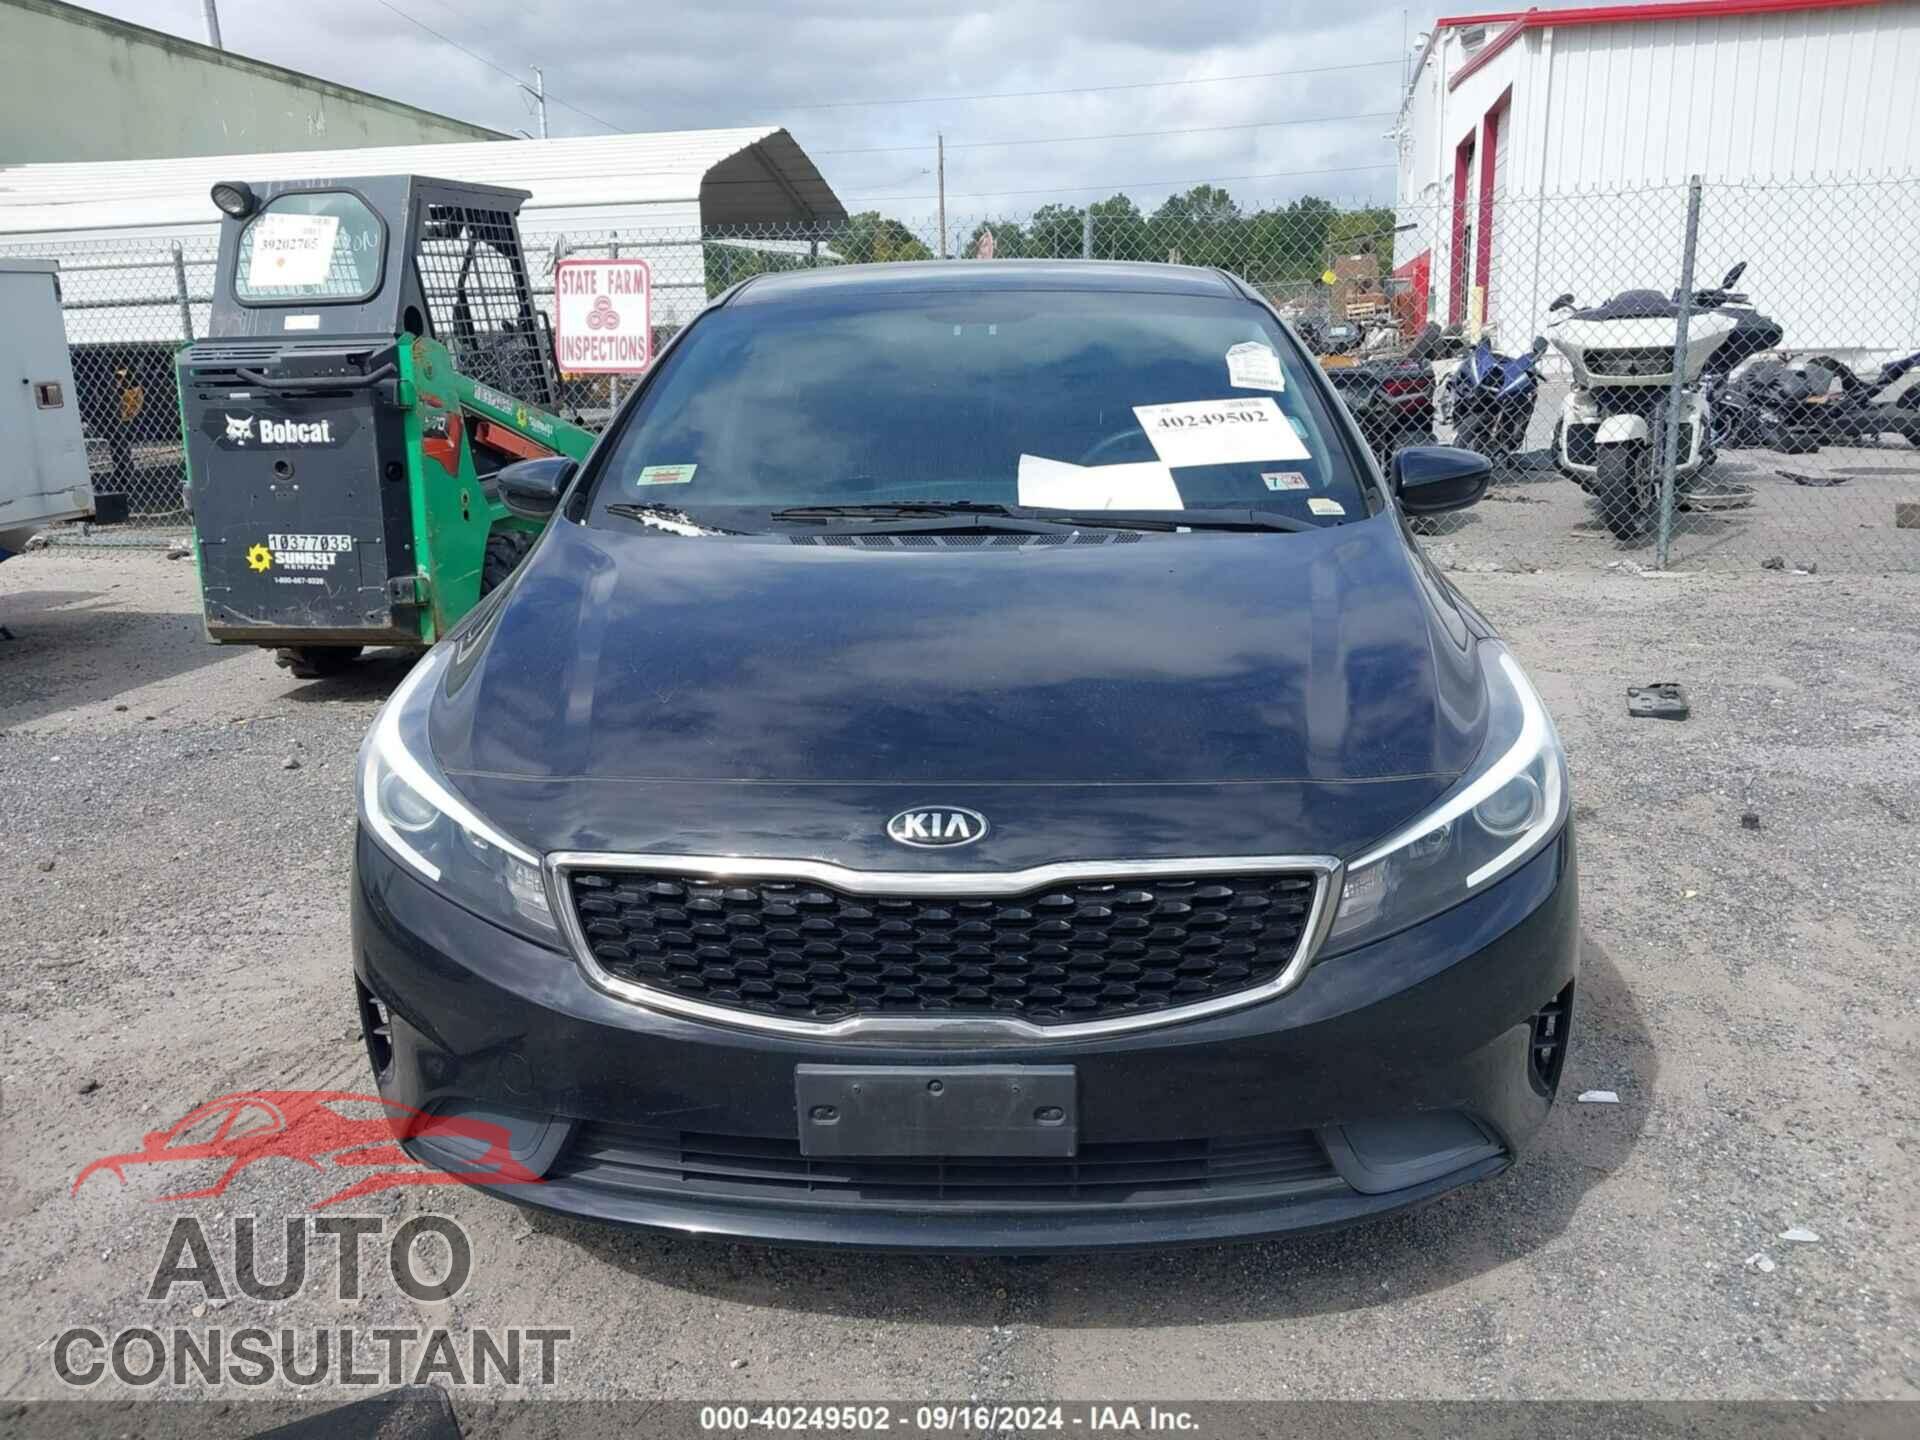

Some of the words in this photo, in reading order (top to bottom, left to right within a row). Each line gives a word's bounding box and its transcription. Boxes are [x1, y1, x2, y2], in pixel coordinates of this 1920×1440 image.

[562, 270, 597, 294] STATE
[607, 269, 644, 294] FARM
[561, 335, 645, 361] INSPECTIONS
[259, 419, 331, 443] Bobcat
[1158, 410, 1269, 428] 40249502
[270, 535, 350, 550] 10377035
[274, 552, 336, 565] SUNBELT
[903, 813, 971, 838] KIA
